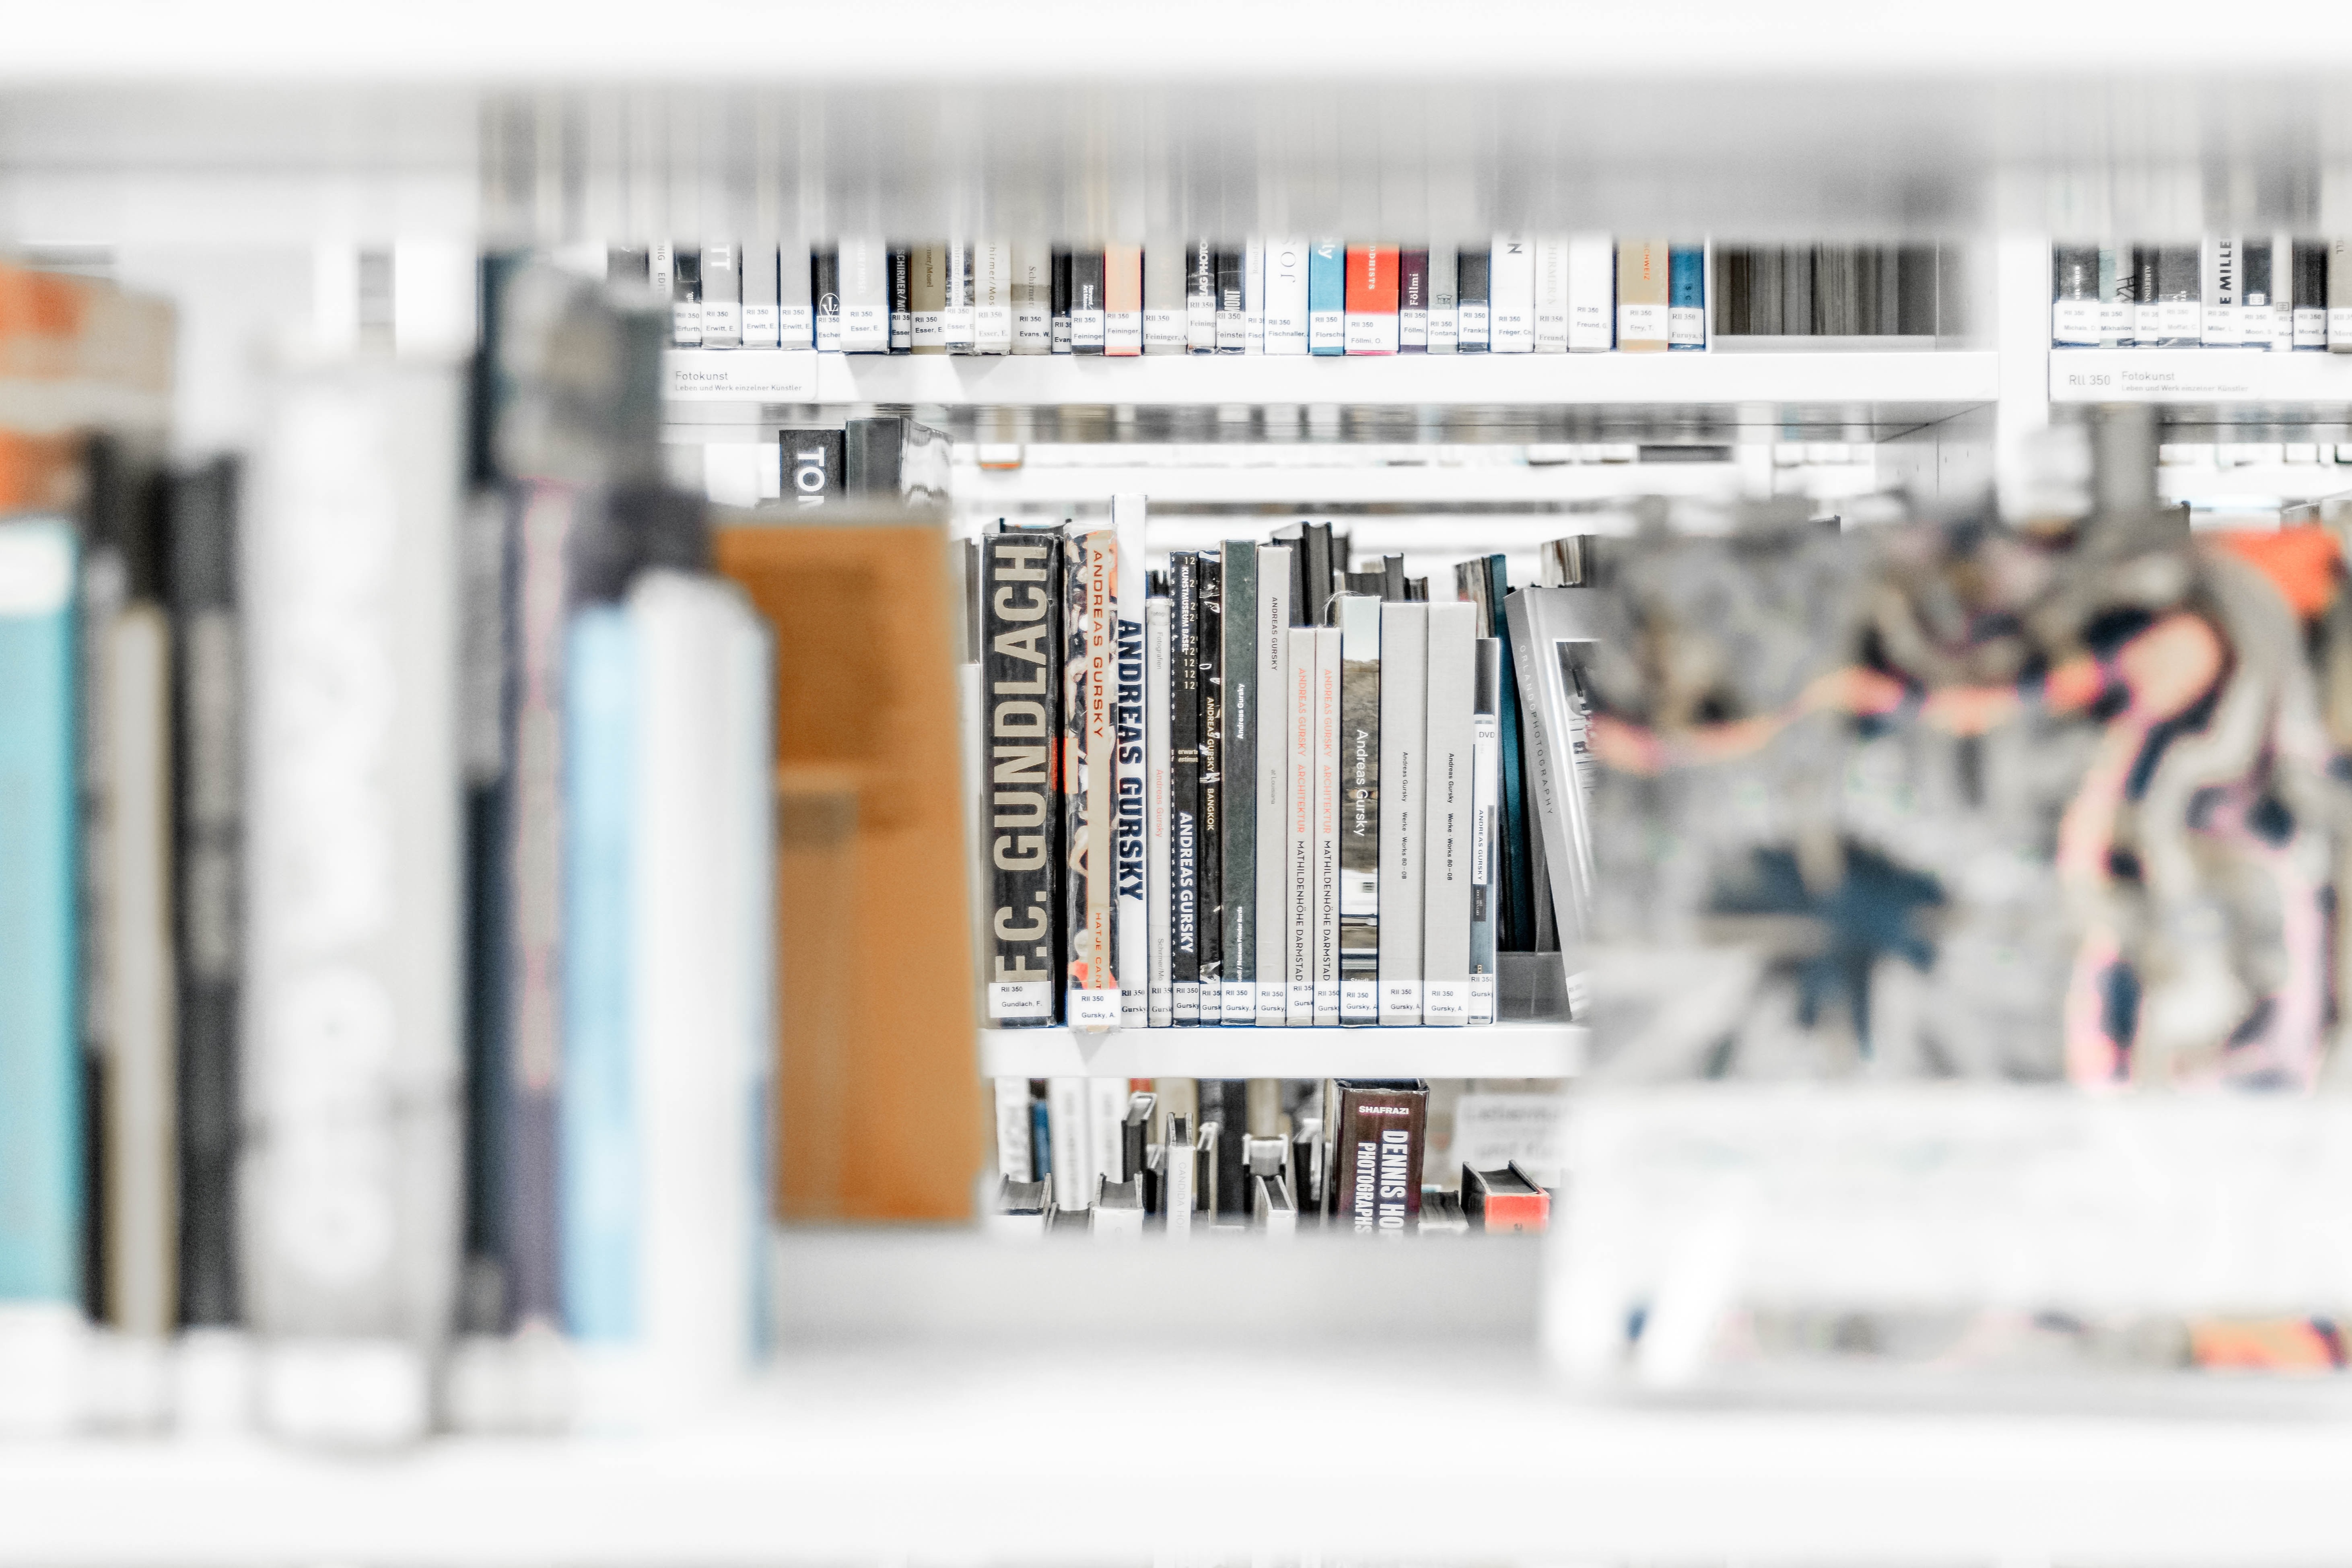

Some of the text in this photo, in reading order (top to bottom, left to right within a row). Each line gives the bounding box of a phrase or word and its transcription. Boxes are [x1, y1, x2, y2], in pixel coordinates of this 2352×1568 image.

[1409, 273, 1419, 306] Föllmi
[676, 371, 728, 380] Fotokunst
[2122, 371, 2175, 381] Fotokunst
[1184, 556, 1195, 565] 12
[1092, 550, 1104, 738] ANDREAS GURSKY
[1184, 659, 1195, 667] 12
[1184, 670, 1195, 678] 12
[1184, 681, 1195, 690] 12
[993, 546, 1047, 983] F.C. GUNDLACH
[1117, 619, 1144, 900] ANDREAS GURSKY
[1353, 729, 1369, 837] Andreas Gursky
[1531, 711, 1553, 814] PHOTOGRAPHY
[1154, 807, 1163, 838] Gursky
[1295, 668, 1307, 982] ANDREAS GURSKY ARCHITEKTUR MATHILDENHÖHE DARMSTAD
[1322, 669, 1334, 982] ANDREAS GURSKY ARCHITEKTUR MATHILDENHÖHE DARMSTAD
[1180, 812, 1193, 953] ANDREAS GURSKY
[1359, 1105, 1409, 1115] SHAFRAZI
[1177, 1162, 1187, 1207] CANDIDA
[1354, 1142, 1376, 1234] PHOTOGRAPHS
[1380, 1130, 1409, 1198] DENNIS
